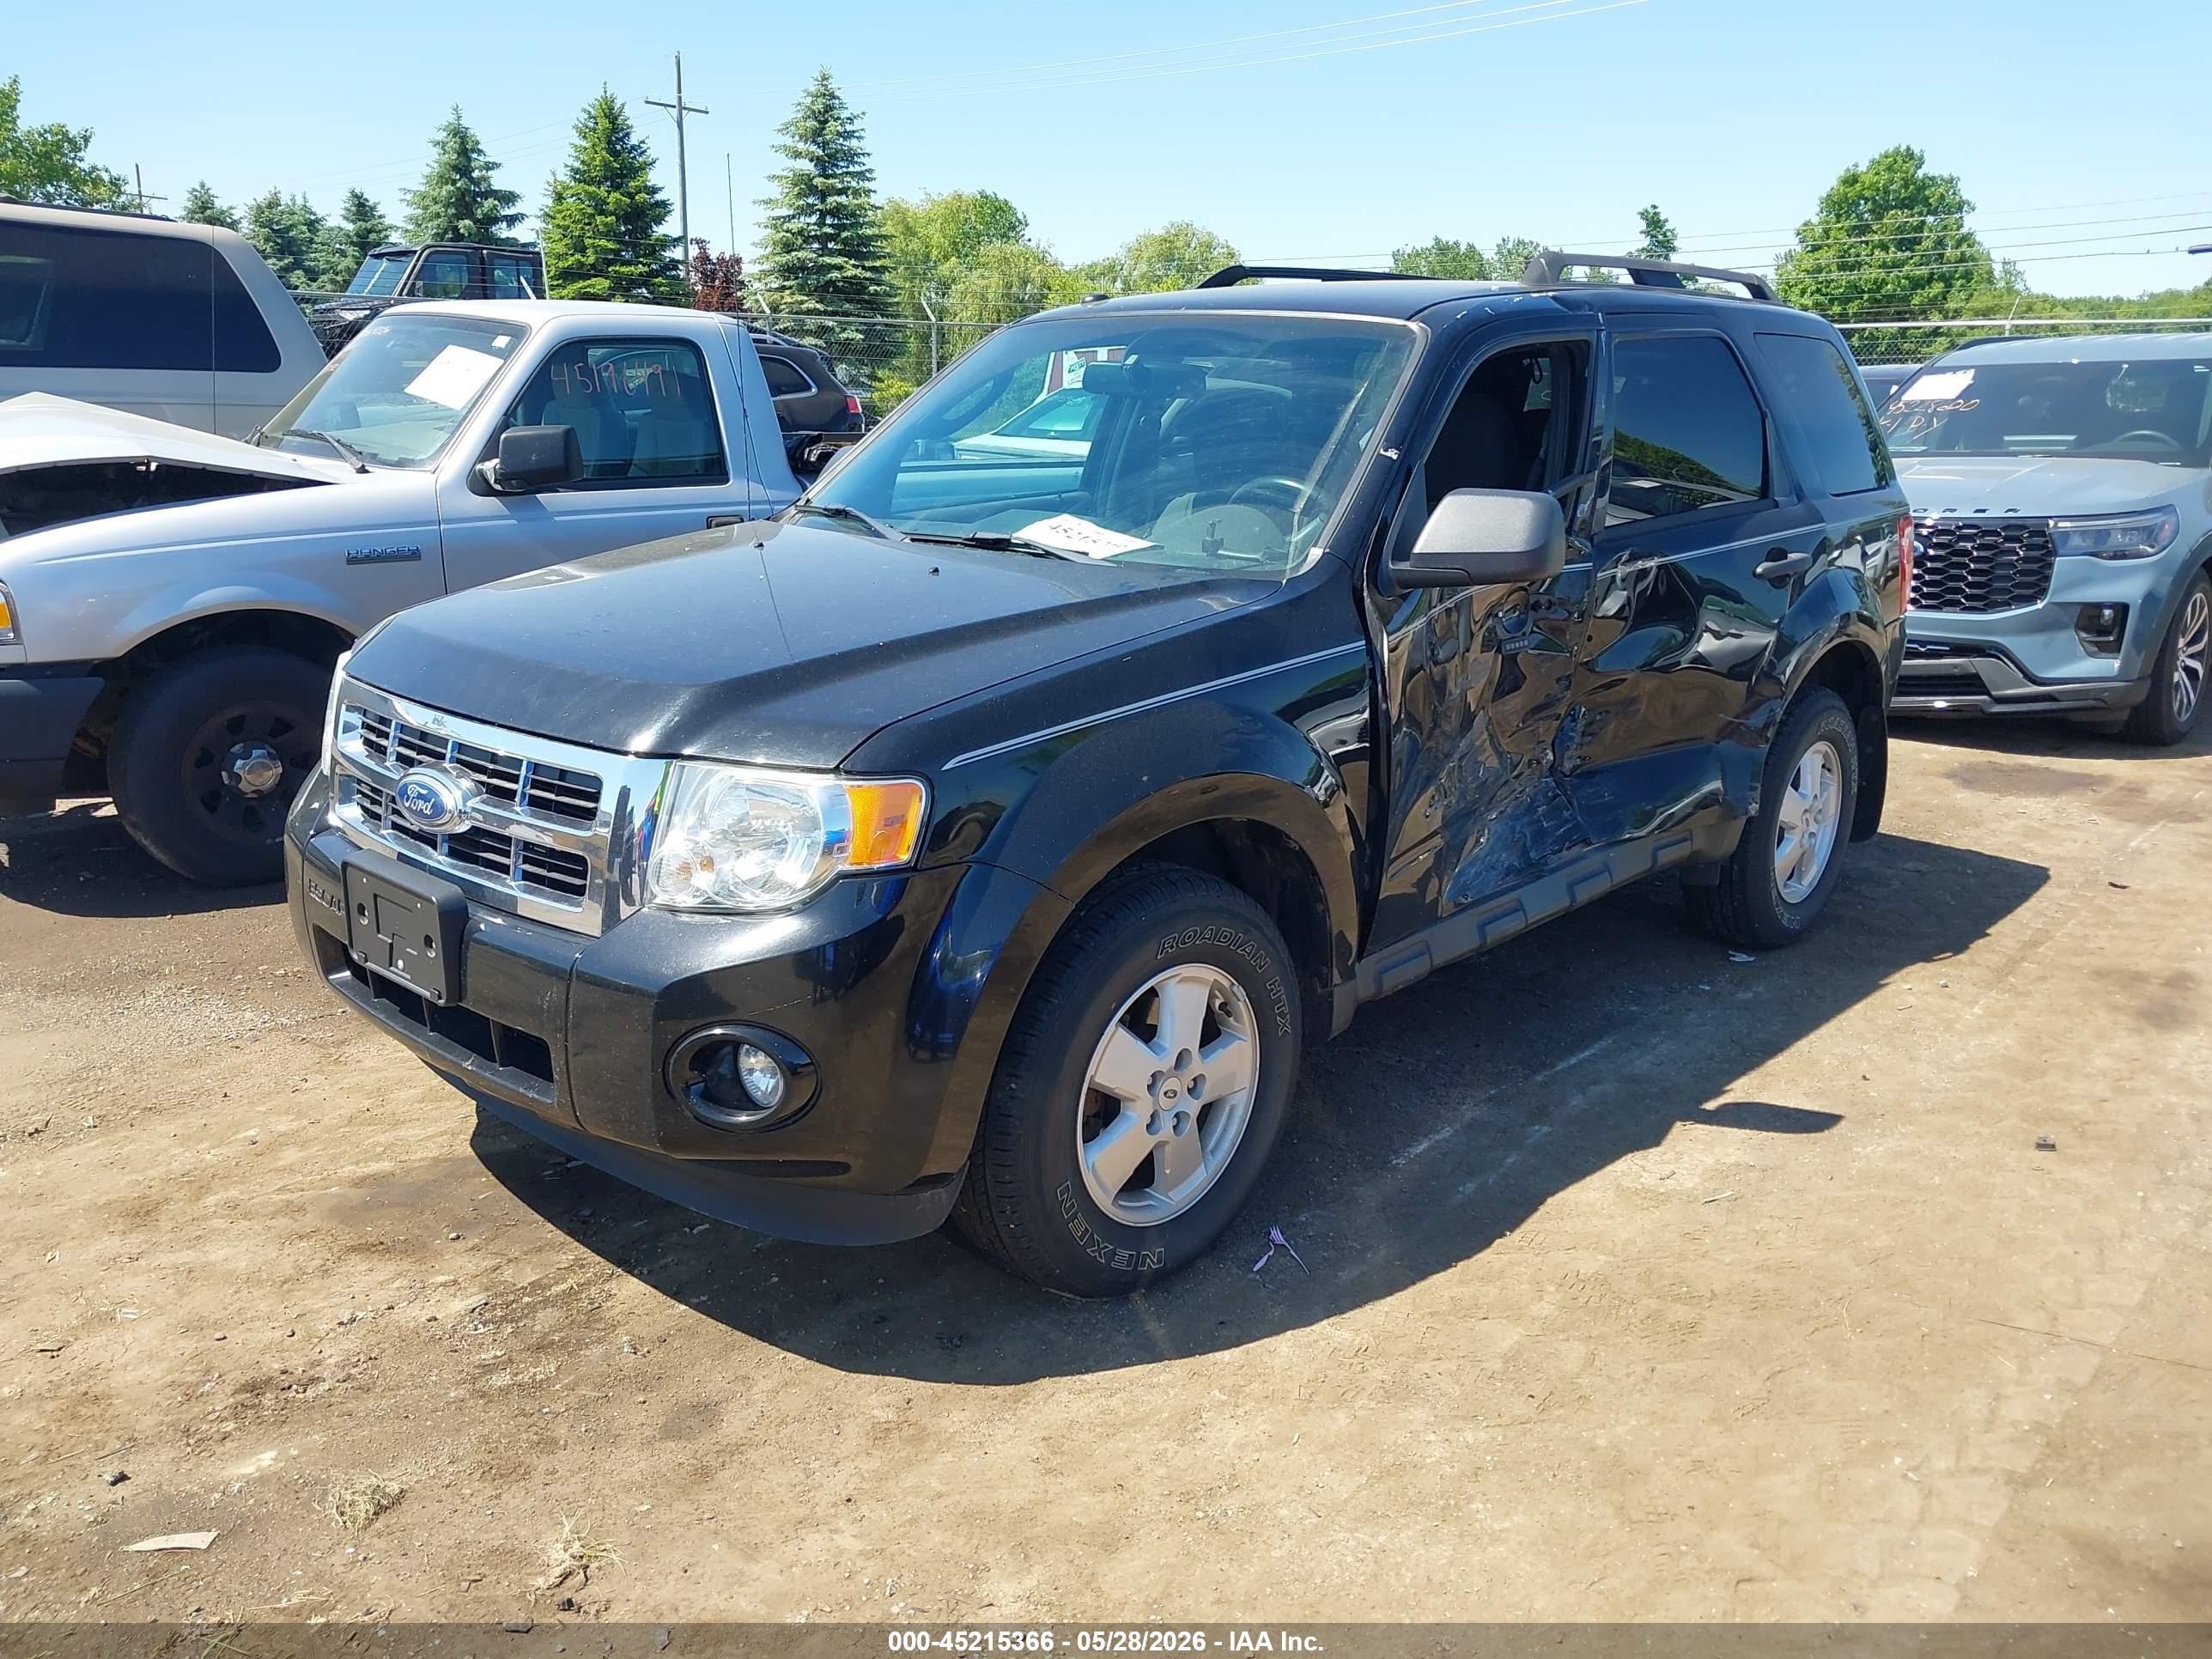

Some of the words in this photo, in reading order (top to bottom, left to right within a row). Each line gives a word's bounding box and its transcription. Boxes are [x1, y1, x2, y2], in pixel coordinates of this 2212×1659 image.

[344, 544, 421, 559] RANGER
[404, 784, 435, 815] Ford
[1157, 926, 1271, 974] ROADIAN
[1265, 975, 1292, 1037] HTX
[1056, 1181, 1165, 1271] NEXEN
